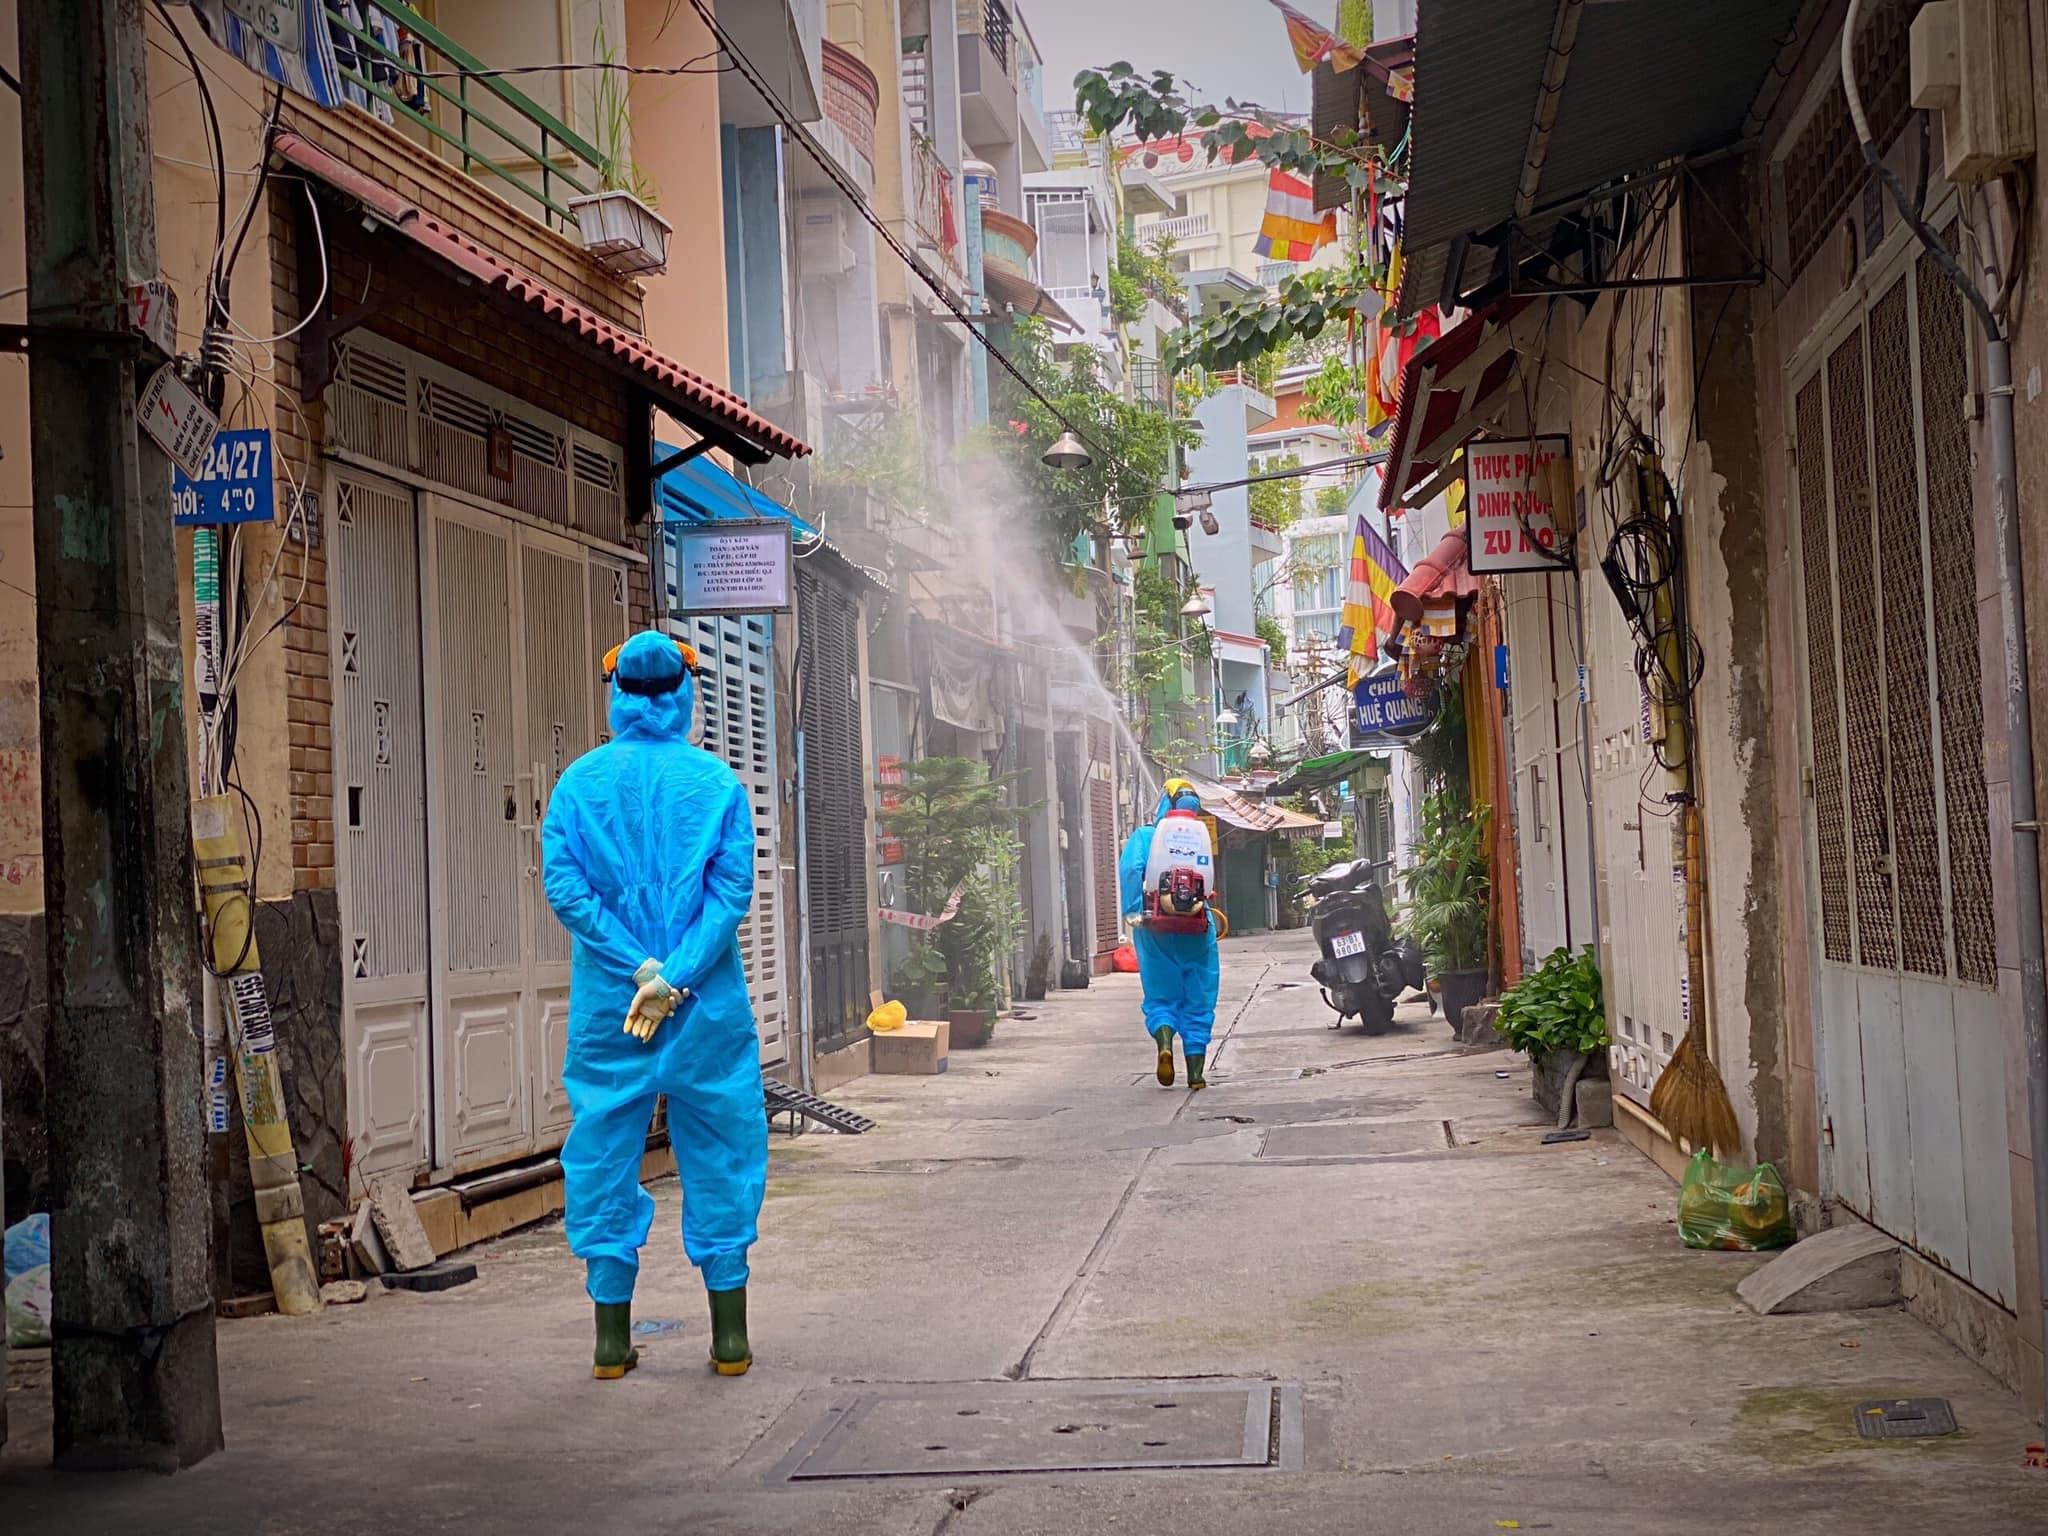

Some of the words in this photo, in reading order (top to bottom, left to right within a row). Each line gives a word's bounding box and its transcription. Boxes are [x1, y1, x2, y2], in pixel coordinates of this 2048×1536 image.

[192, 440, 262, 483] 24/27
[1473, 455, 1511, 484] THỰC
[1477, 492, 1510, 518] DINH
[1484, 530, 1512, 555] ZU
[1360, 699, 1383, 727] HUỆ
[1385, 698, 1423, 724] QUANG
